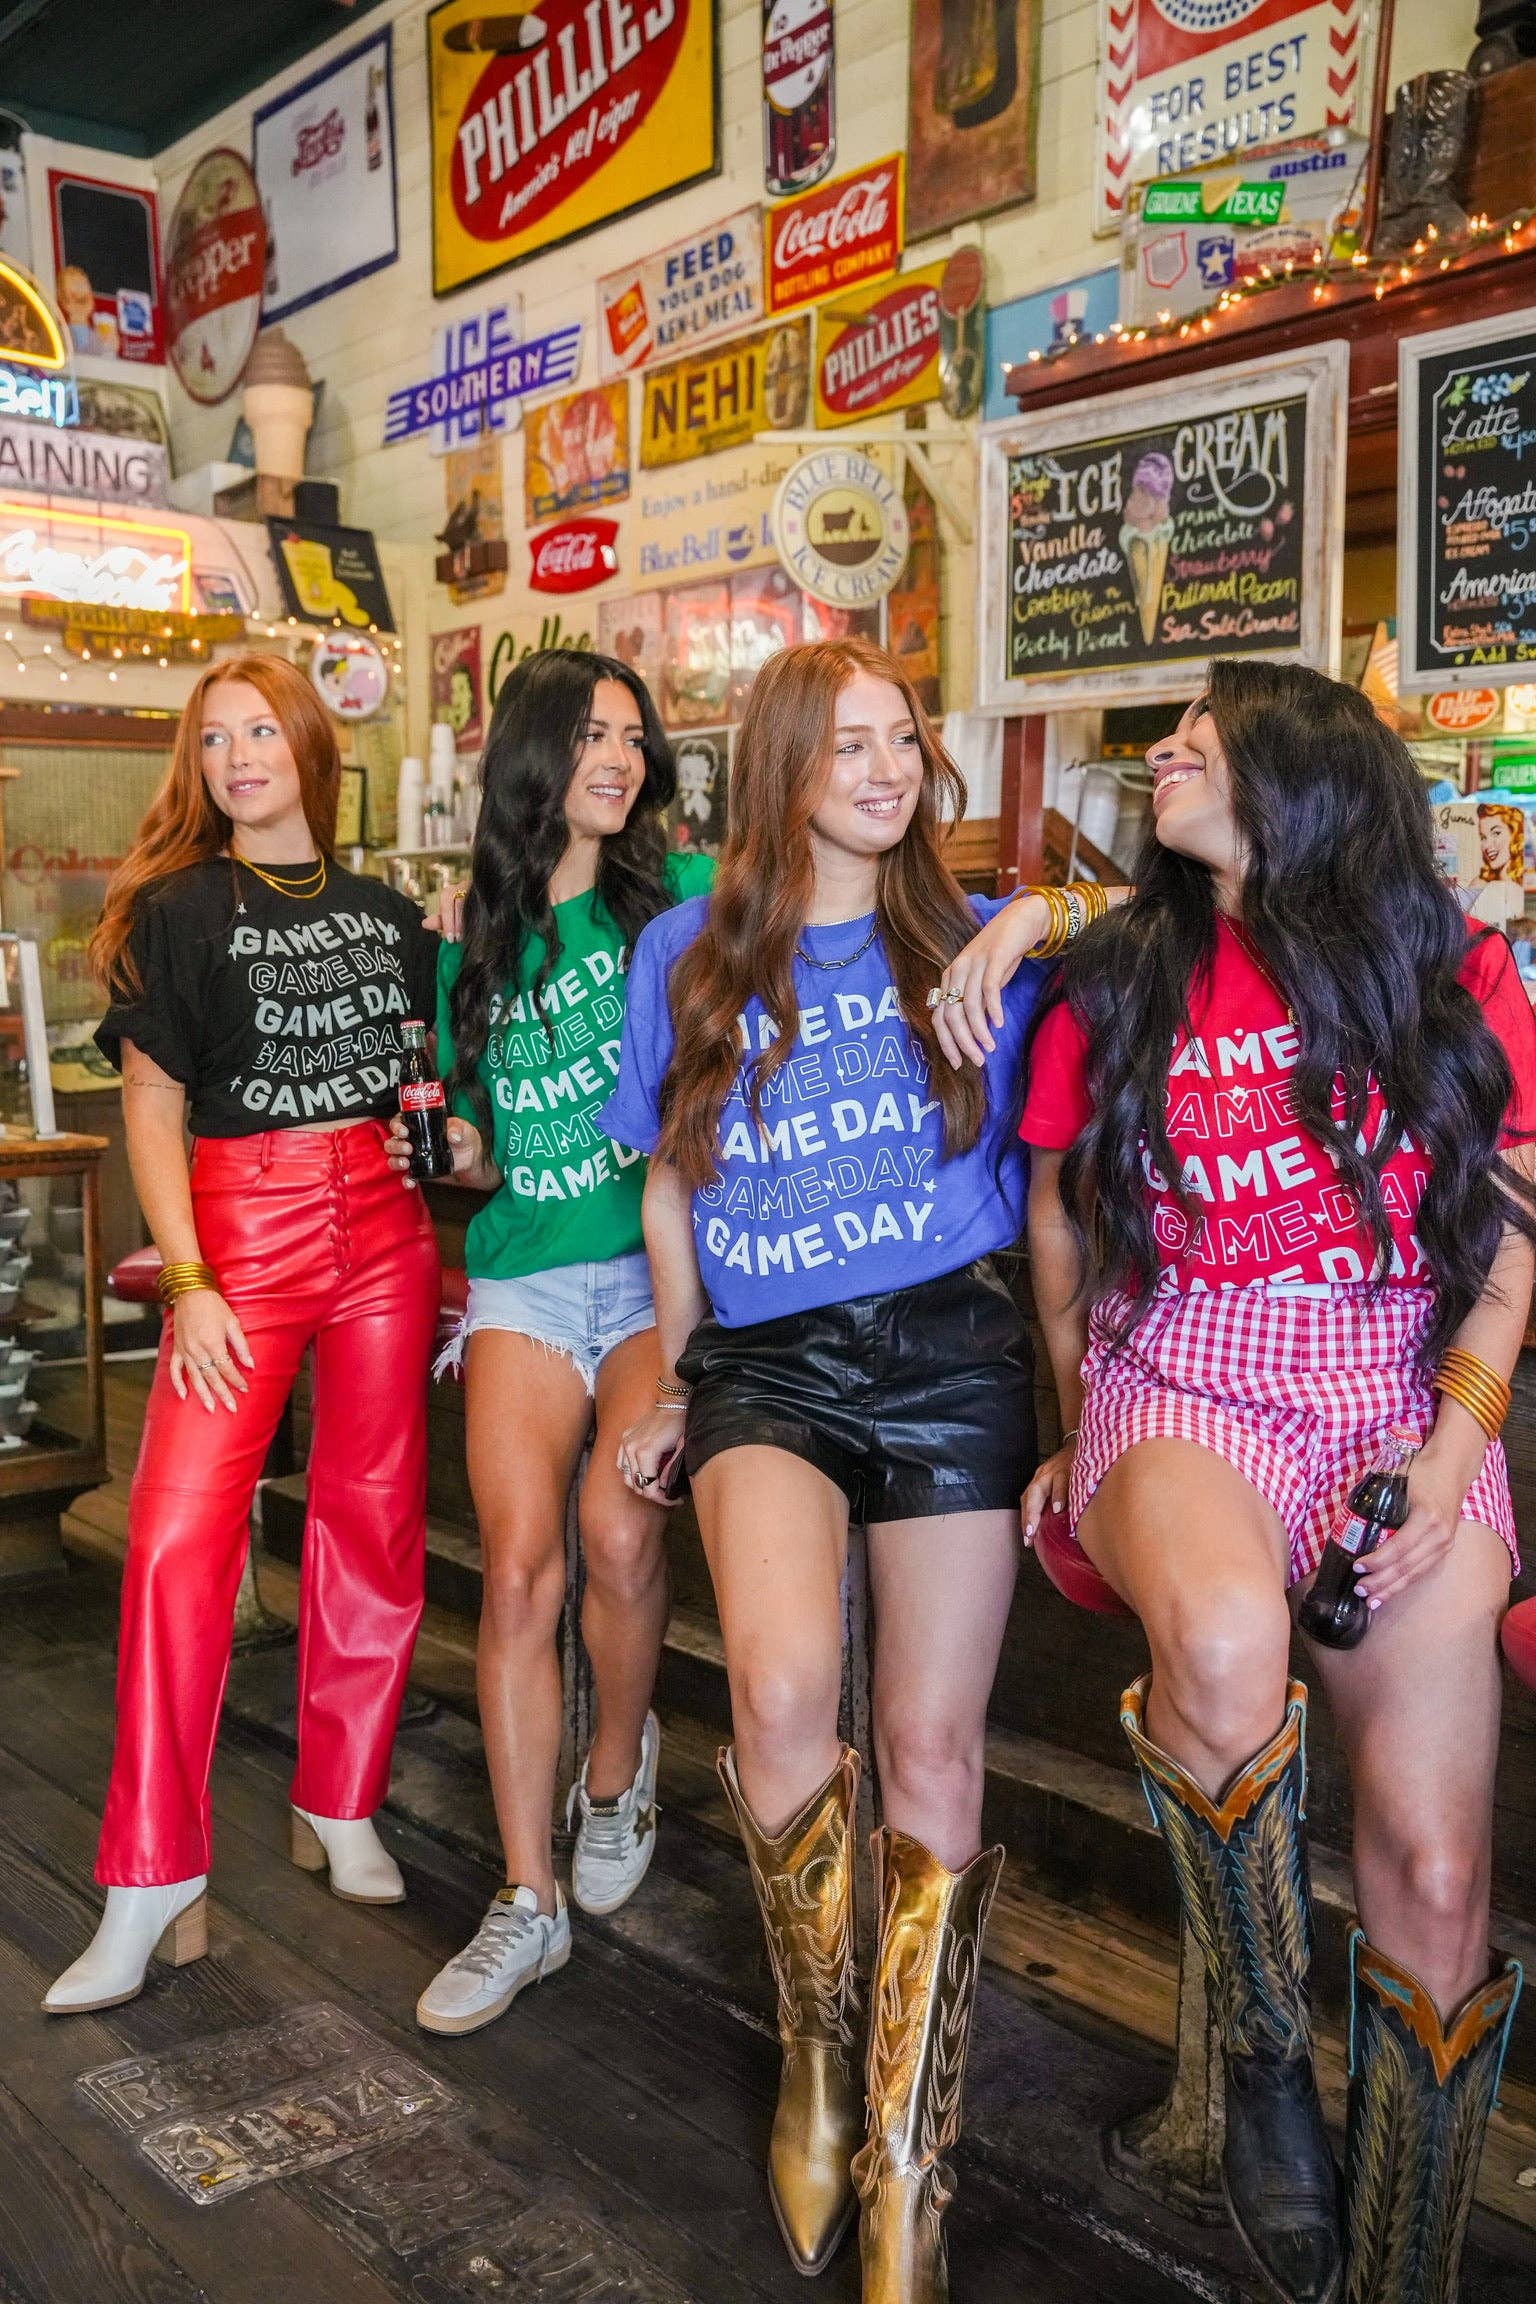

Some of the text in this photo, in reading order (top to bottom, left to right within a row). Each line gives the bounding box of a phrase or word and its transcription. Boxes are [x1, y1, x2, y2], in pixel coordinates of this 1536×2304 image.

[1152, 34, 1307, 129] FOR BEST
[1158, 93, 1295, 174] RESULTS
[1269, 153, 1346, 179] austin
[774, 172, 894, 269] Coca-Cola
[1225, 190, 1281, 215] TEXAS
[665, 232, 733, 287] FEED
[658, 262, 745, 313] YOUR DOG
[705, 286, 752, 322] MEAL
[824, 290, 939, 397] PHILLIES
[414, 347, 544, 424] SOUTHERN
[651, 355, 755, 440] NEHI
[1441, 404, 1520, 448] Latte
[786, 456, 896, 511] BLUE BELL
[1042, 449, 1123, 521] ICE
[1172, 409, 1289, 517] CREAM
[640, 543, 681, 576] Blue
[683, 527, 720, 567] Bell
[1014, 546, 1123, 594] Chocolate
[1020, 524, 1106, 565] Vanilla
[793, 545, 902, 598] ICE CREAM
[234, 912, 397, 957] GAME DAY
[249, 955, 357, 995] GAME
[255, 994, 363, 1037] GAME
[251, 1034, 356, 1077] GAME
[403, 1081, 441, 1101] Coca-Cola
[496, 1056, 605, 1113] GAME
[831, 1093, 941, 1142] DAY
[827, 1147, 934, 1200] DAY
[1153, 1199, 1318, 1266] GAME
